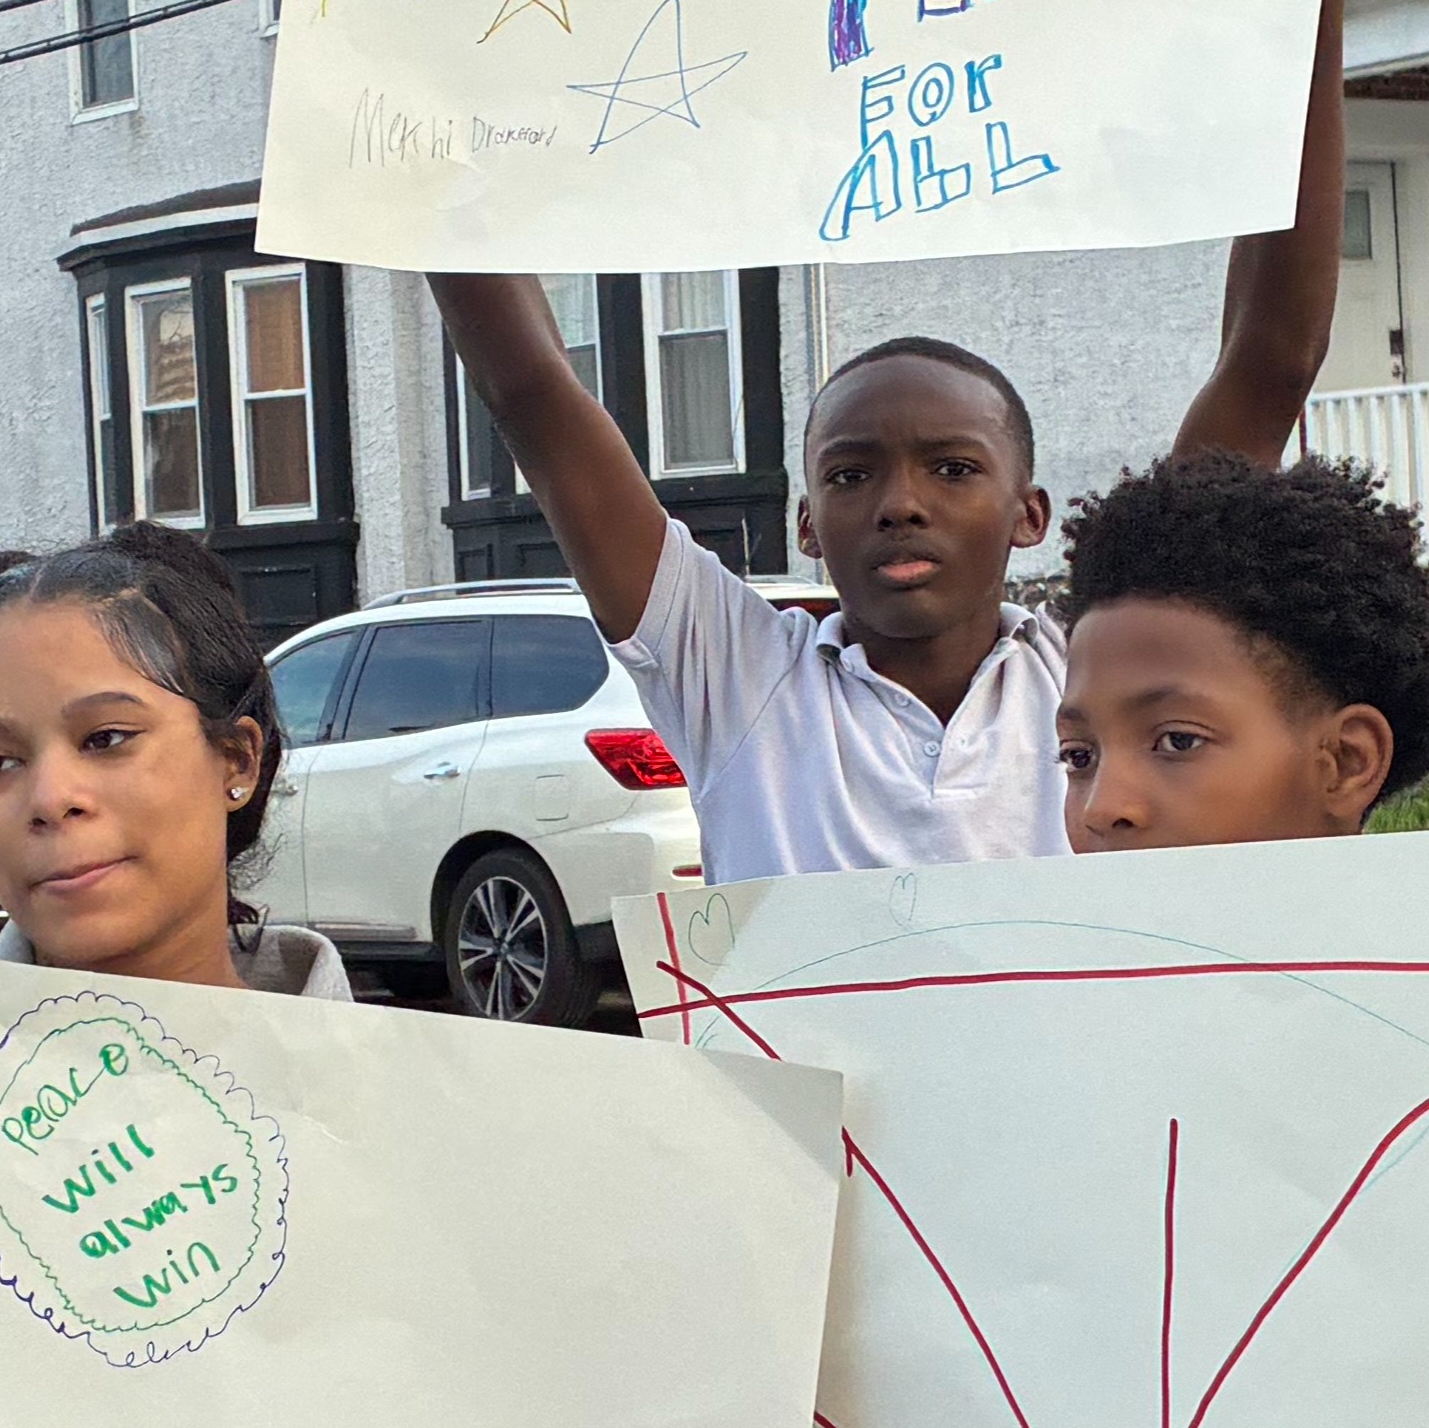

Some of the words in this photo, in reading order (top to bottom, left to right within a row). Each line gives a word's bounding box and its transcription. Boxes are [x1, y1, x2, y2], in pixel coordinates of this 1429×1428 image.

[819, 121, 1062, 242] ALL
[42, 1124, 155, 1214] will
[79, 1163, 239, 1259] always
[112, 1241, 221, 1308] win
